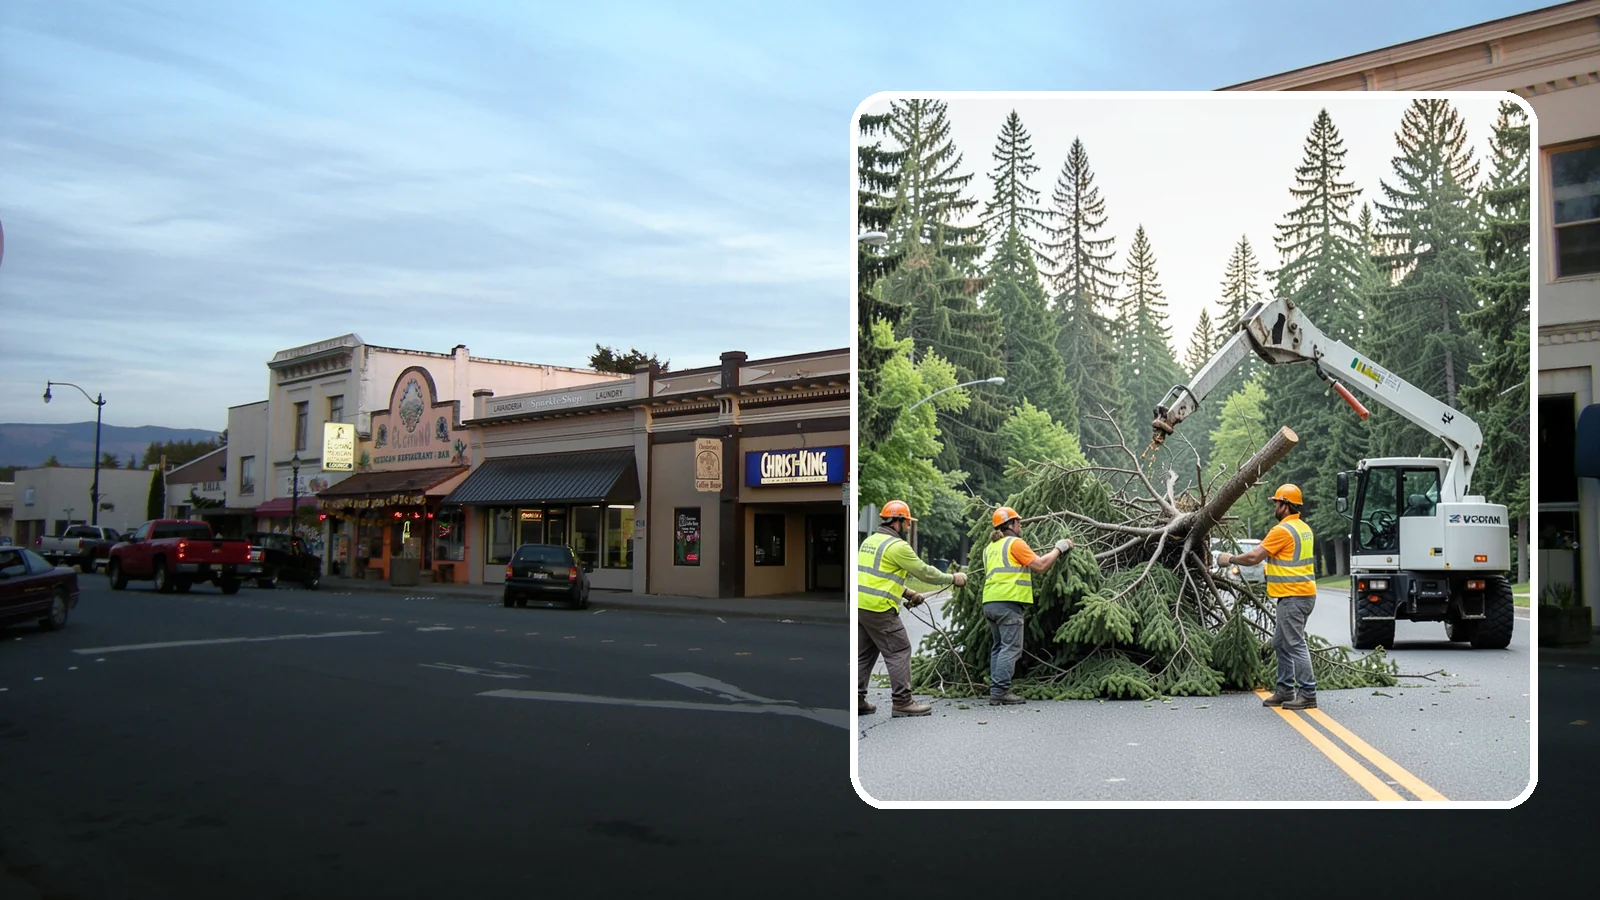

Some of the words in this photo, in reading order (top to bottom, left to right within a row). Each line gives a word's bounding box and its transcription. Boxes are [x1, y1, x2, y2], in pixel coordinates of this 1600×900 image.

[560, 394, 583, 404] Shop
[595, 389, 623, 400] LAUNDRY
[493, 402, 523, 413] LAVANDERIA
[374, 455, 396, 464] MEXICAN
[397, 451, 434, 463] RESTAURANT
[437, 450, 450, 459] BAR
[761, 452, 797, 478] CHRIST
[799, 450, 827, 476] KING
